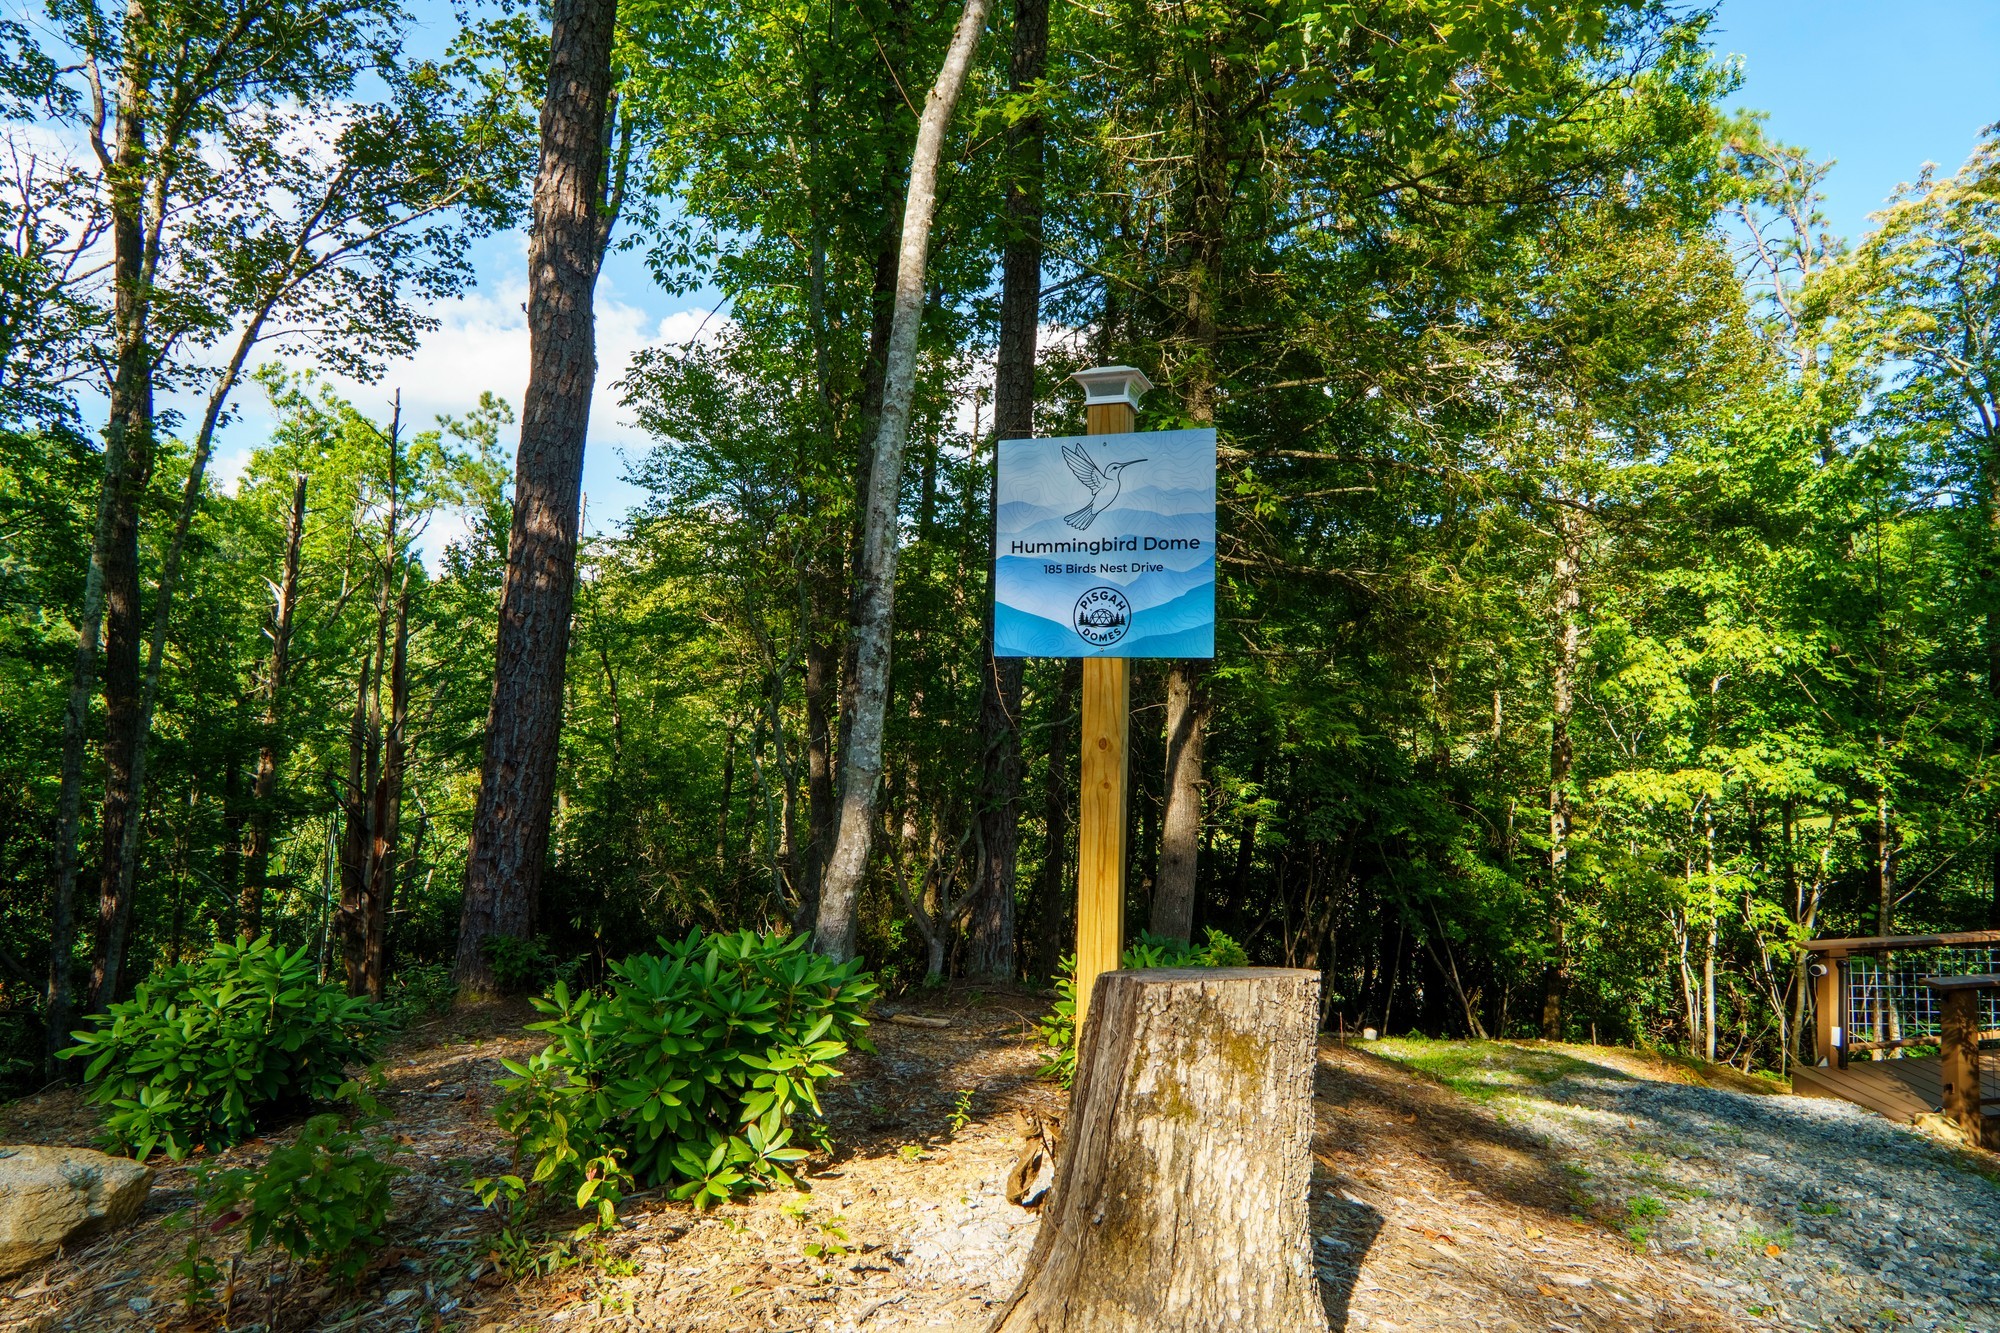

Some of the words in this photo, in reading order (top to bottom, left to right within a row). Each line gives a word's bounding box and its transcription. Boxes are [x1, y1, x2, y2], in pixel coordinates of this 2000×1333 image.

[1011, 536, 1138, 556] Hummingbird
[1143, 536, 1201, 551] Dome
[1043, 564, 1063, 574] 185
[1066, 563, 1097, 574] Birds
[1100, 562, 1128, 573] Nest
[1131, 562, 1164, 573] Drive
[1080, 590, 1126, 611] PISGAH
[1082, 627, 1121, 642] DOMES
